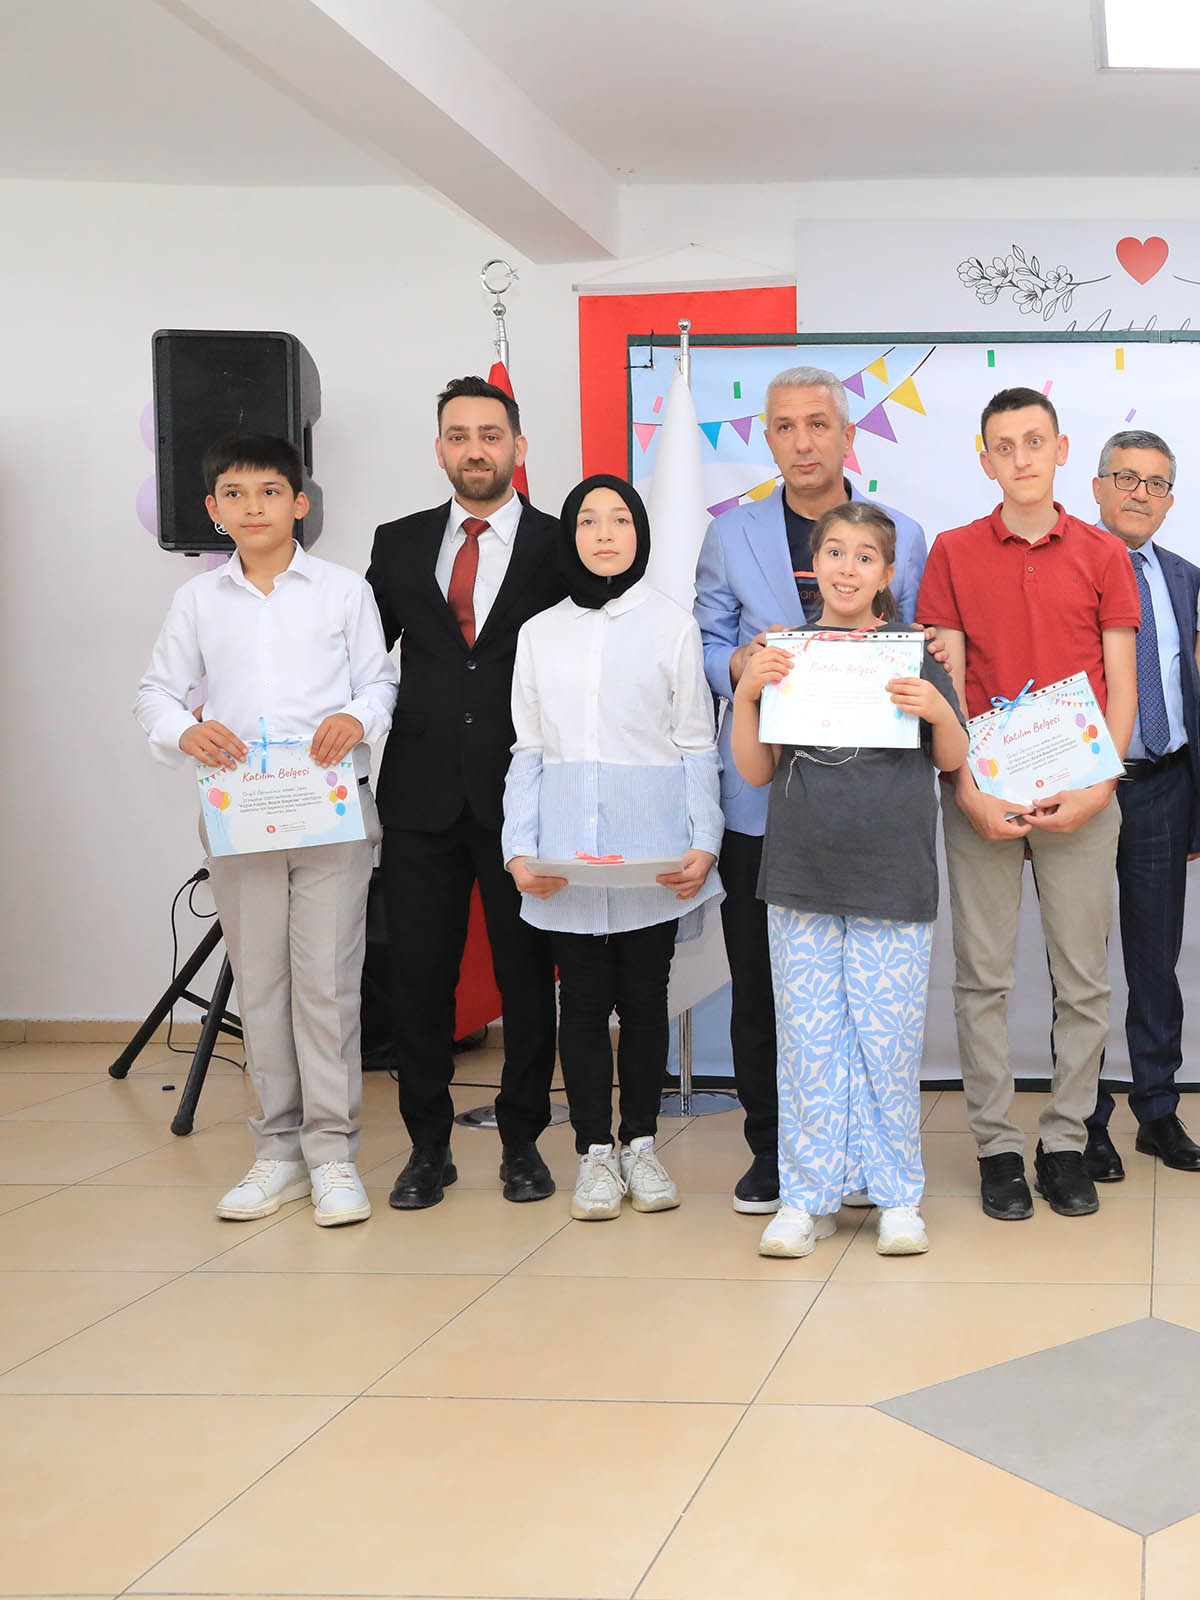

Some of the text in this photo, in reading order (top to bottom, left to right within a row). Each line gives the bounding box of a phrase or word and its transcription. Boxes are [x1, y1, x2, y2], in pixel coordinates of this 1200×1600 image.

[1003, 714, 1061, 745] Katılım Belgesi
[242, 767, 310, 782] Katılım Belgesi
